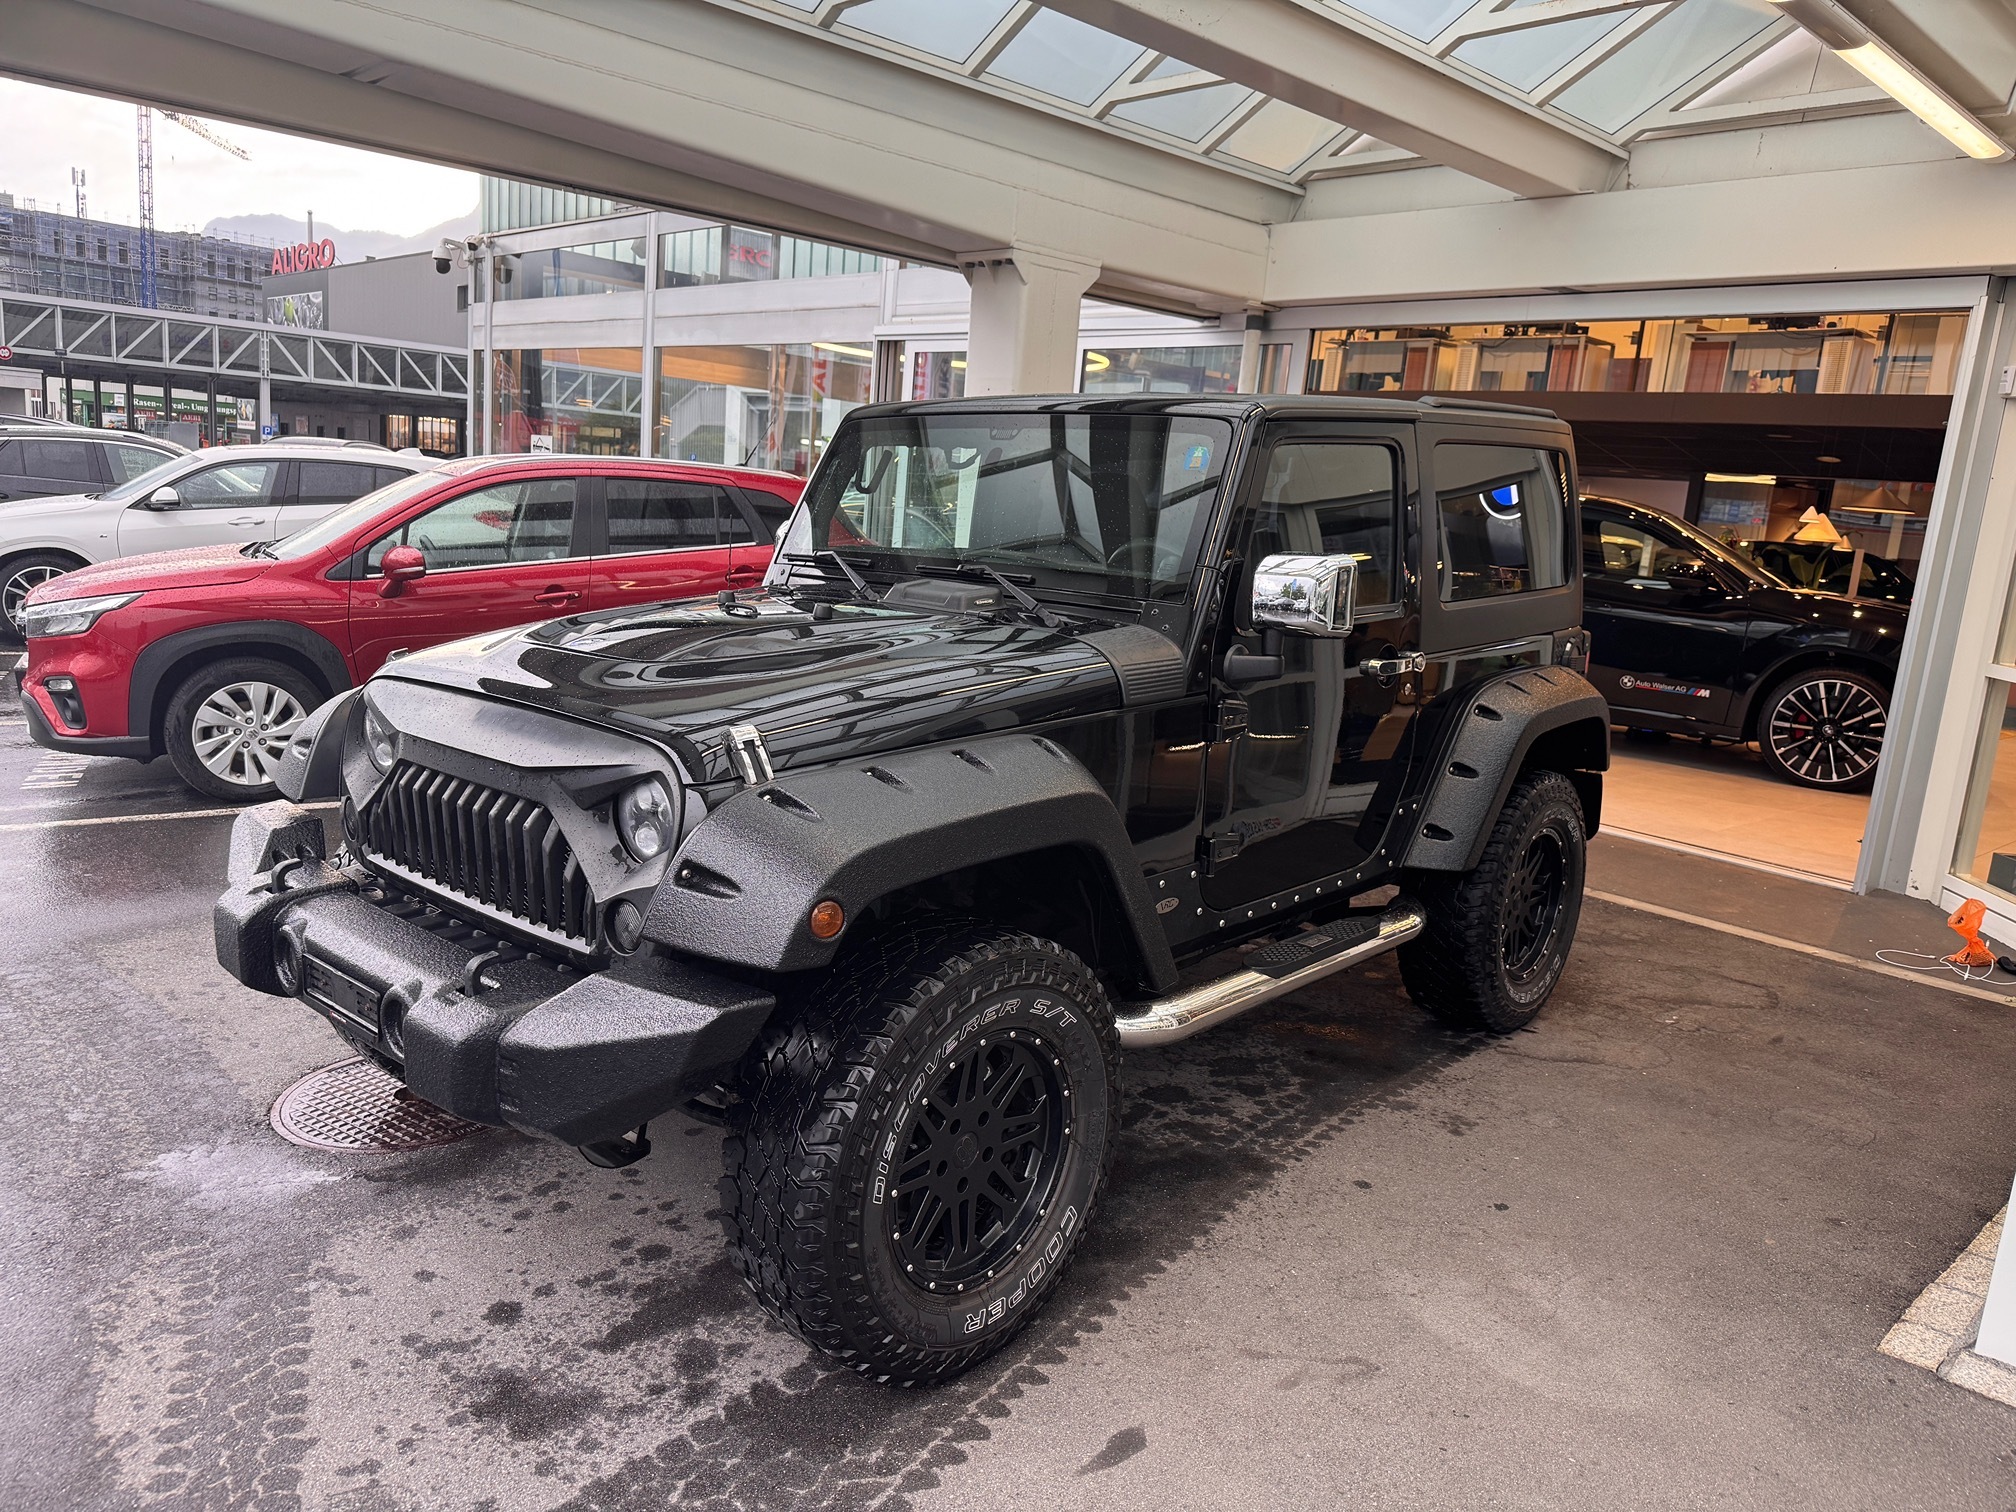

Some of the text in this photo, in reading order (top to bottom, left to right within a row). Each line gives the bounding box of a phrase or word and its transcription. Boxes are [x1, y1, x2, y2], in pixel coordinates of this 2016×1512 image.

[271, 238, 335, 275] ALIGRO
[264, 426, 271, 435] P
[1652, 681, 1675, 691] Walser
[872, 997, 1021, 1206] DISCOVERER
[1028, 998, 1079, 1029] S/T
[962, 1204, 1079, 1336] COOPER
